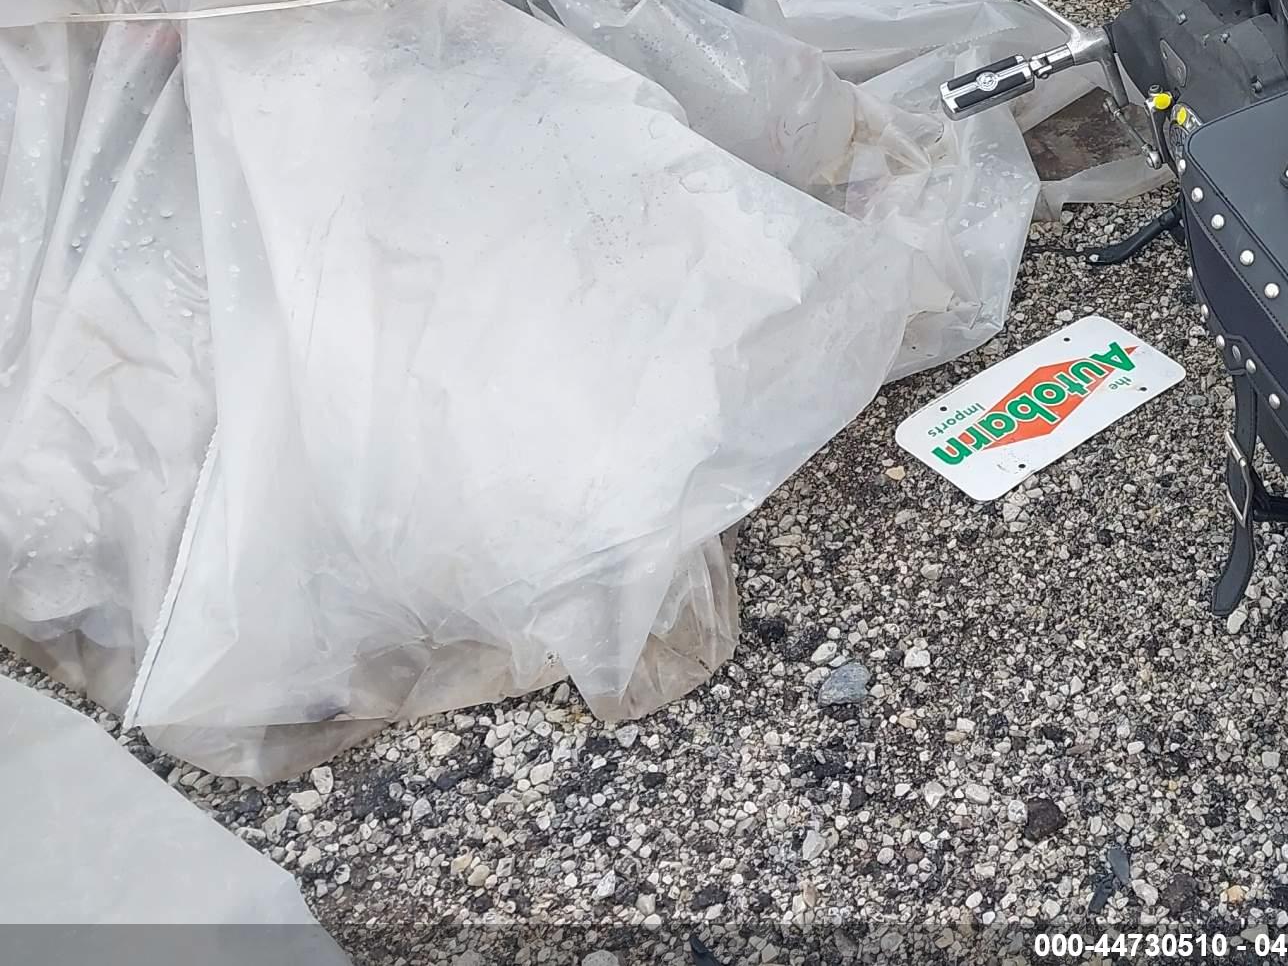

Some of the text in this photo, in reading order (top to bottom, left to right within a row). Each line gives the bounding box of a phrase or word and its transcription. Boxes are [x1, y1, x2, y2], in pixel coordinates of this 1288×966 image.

[1108, 376, 1132, 391] the
[926, 402, 985, 438] Imports
[930, 341, 1137, 466] Autobarn
